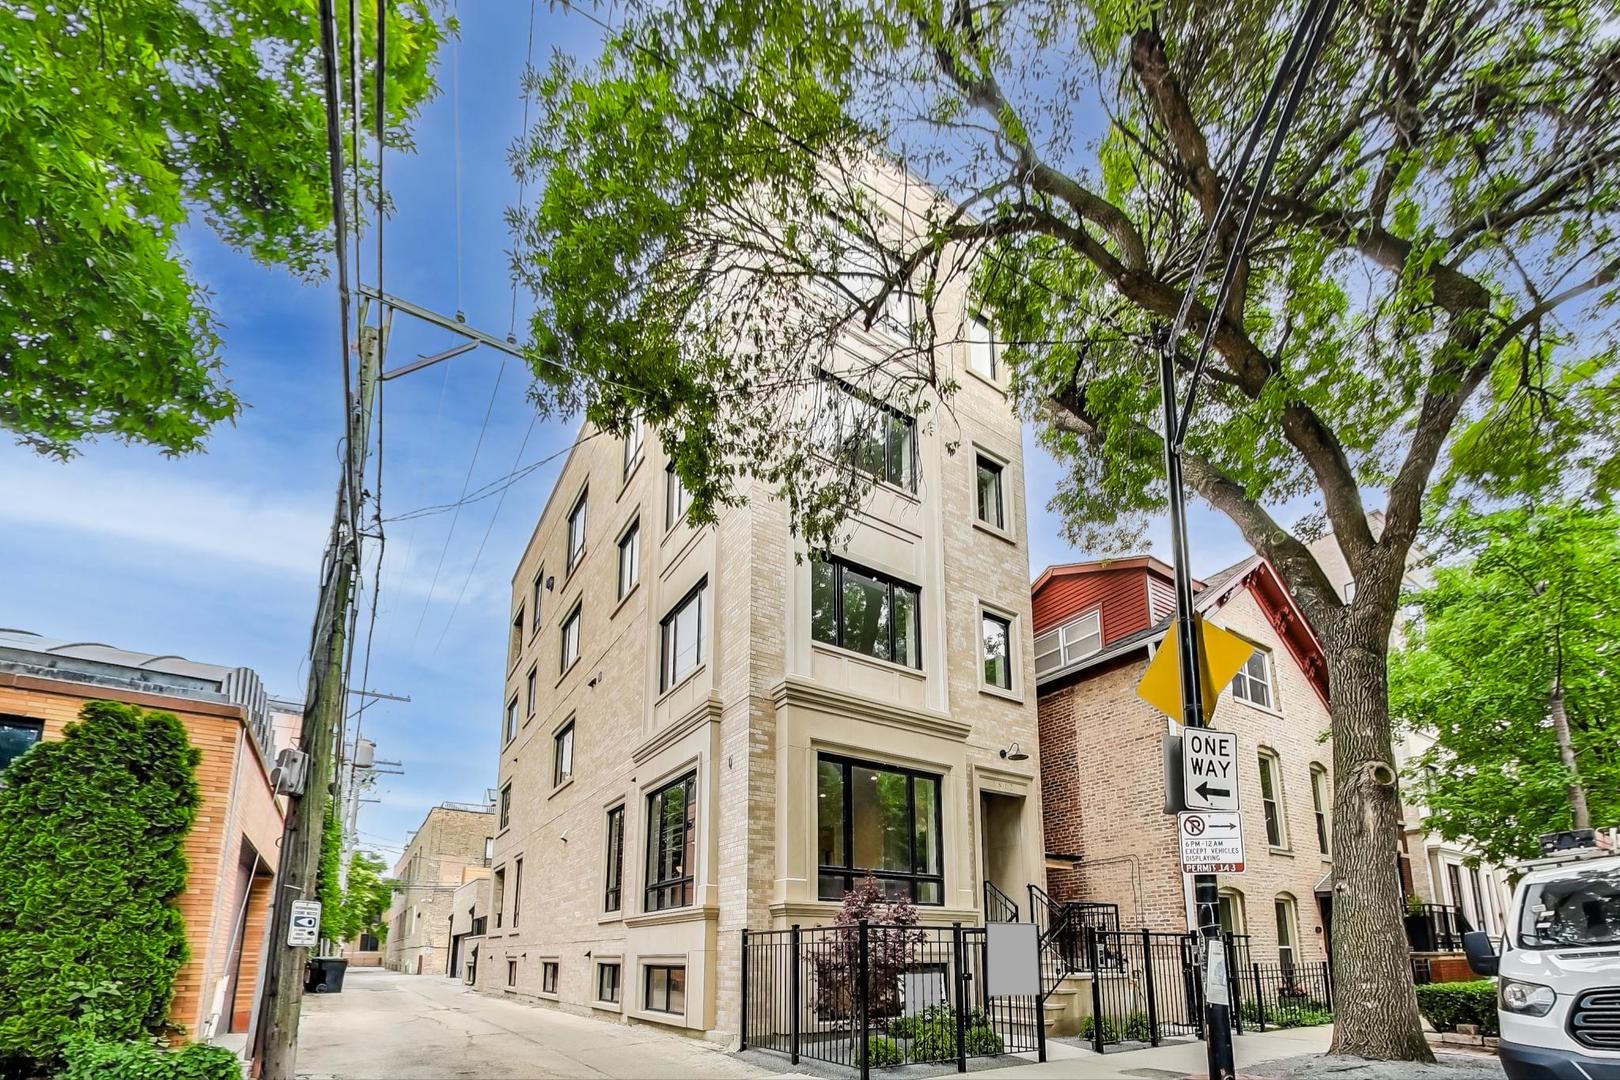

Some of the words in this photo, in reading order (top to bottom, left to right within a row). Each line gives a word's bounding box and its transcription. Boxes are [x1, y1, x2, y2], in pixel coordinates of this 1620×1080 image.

[1191, 735, 1230, 757] ONE
[1191, 757, 1231, 779] WAY
[1210, 847, 1240, 855] VEHICLES
[1186, 864, 1217, 872] PERMIT
